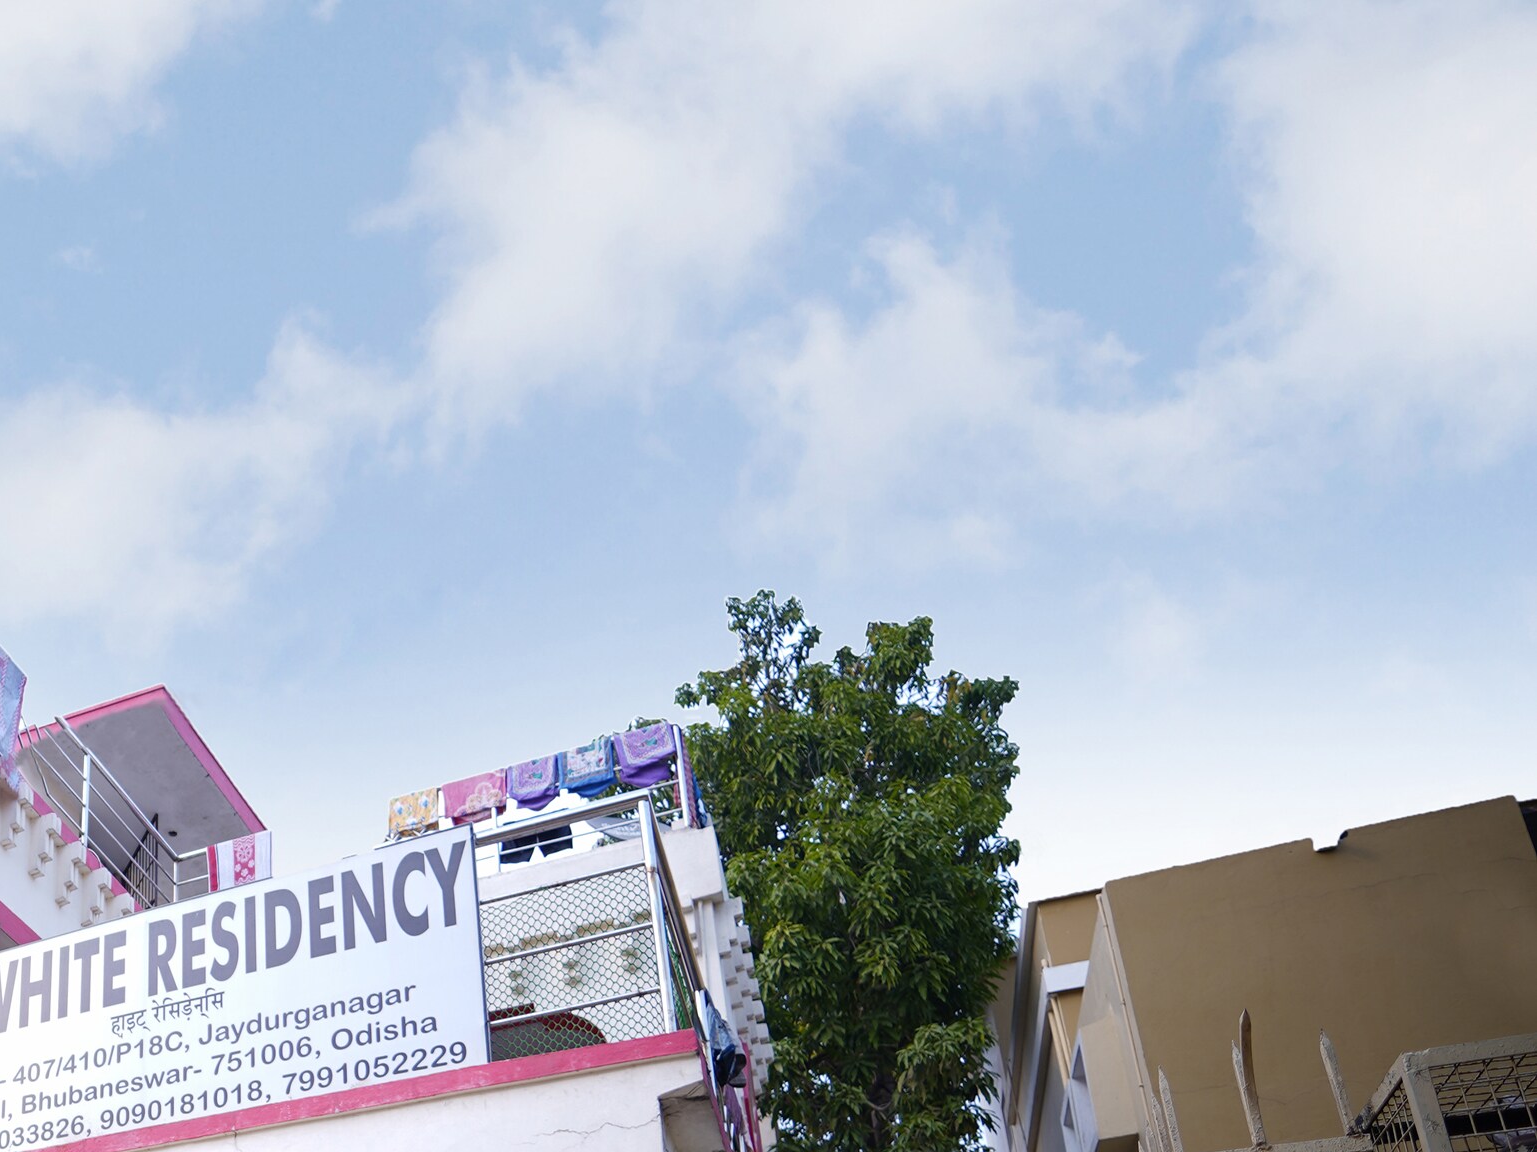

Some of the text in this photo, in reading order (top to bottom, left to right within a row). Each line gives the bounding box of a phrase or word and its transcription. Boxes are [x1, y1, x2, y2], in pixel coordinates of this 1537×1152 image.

[147, 840, 467, 997] RESIDENCY
[198, 984, 416, 1045] Jaydurganagar
[21, 1065, 202, 1114] Bhubaneswar-
[211, 1036, 321, 1076] 751006,
[331, 1015, 437, 1051] Odisha
[100, 1079, 271, 1130] 9090181018,
[282, 1041, 467, 1095] 7991052229
